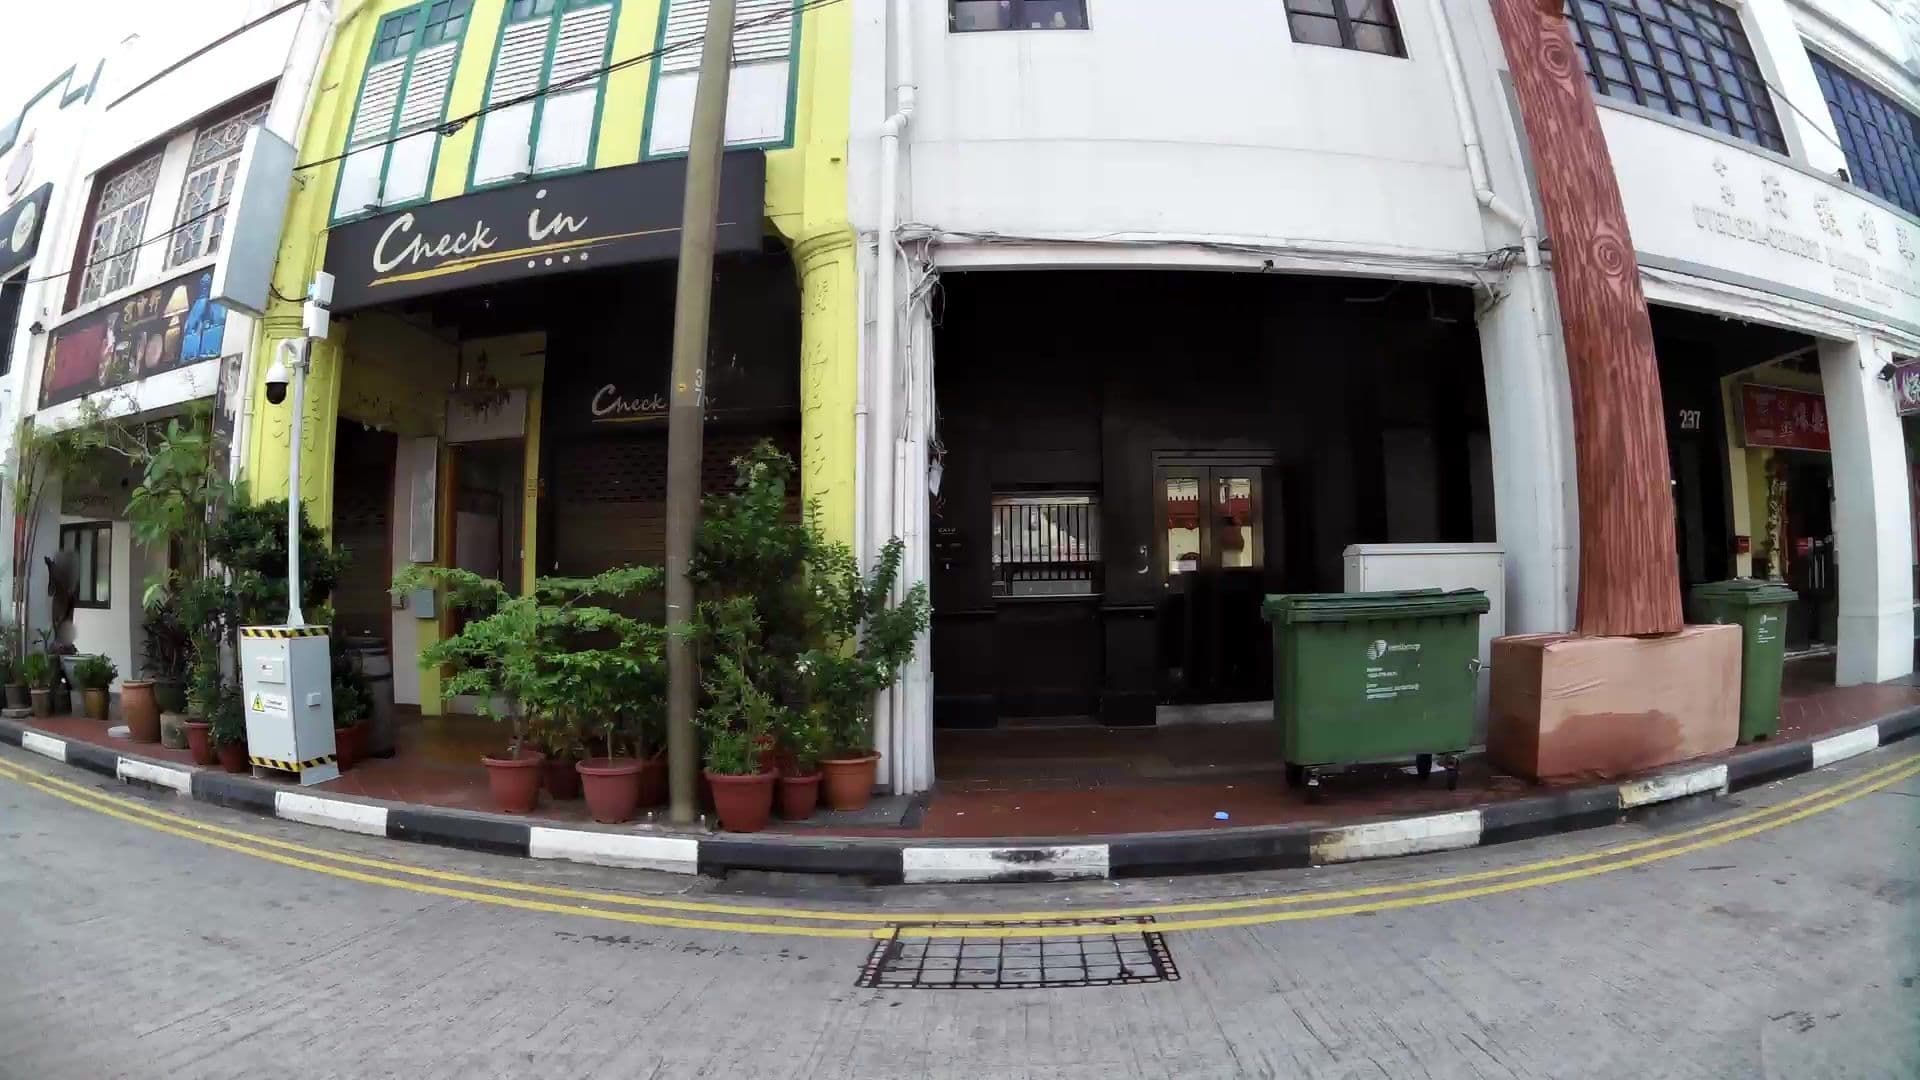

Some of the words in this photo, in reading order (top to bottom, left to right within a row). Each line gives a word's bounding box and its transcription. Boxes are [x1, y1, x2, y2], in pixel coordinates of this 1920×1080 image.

[372, 212, 498, 273] Check
[527, 188, 589, 241] in
[591, 383, 666, 416] Check
[1679, 409, 1701, 430] 237
